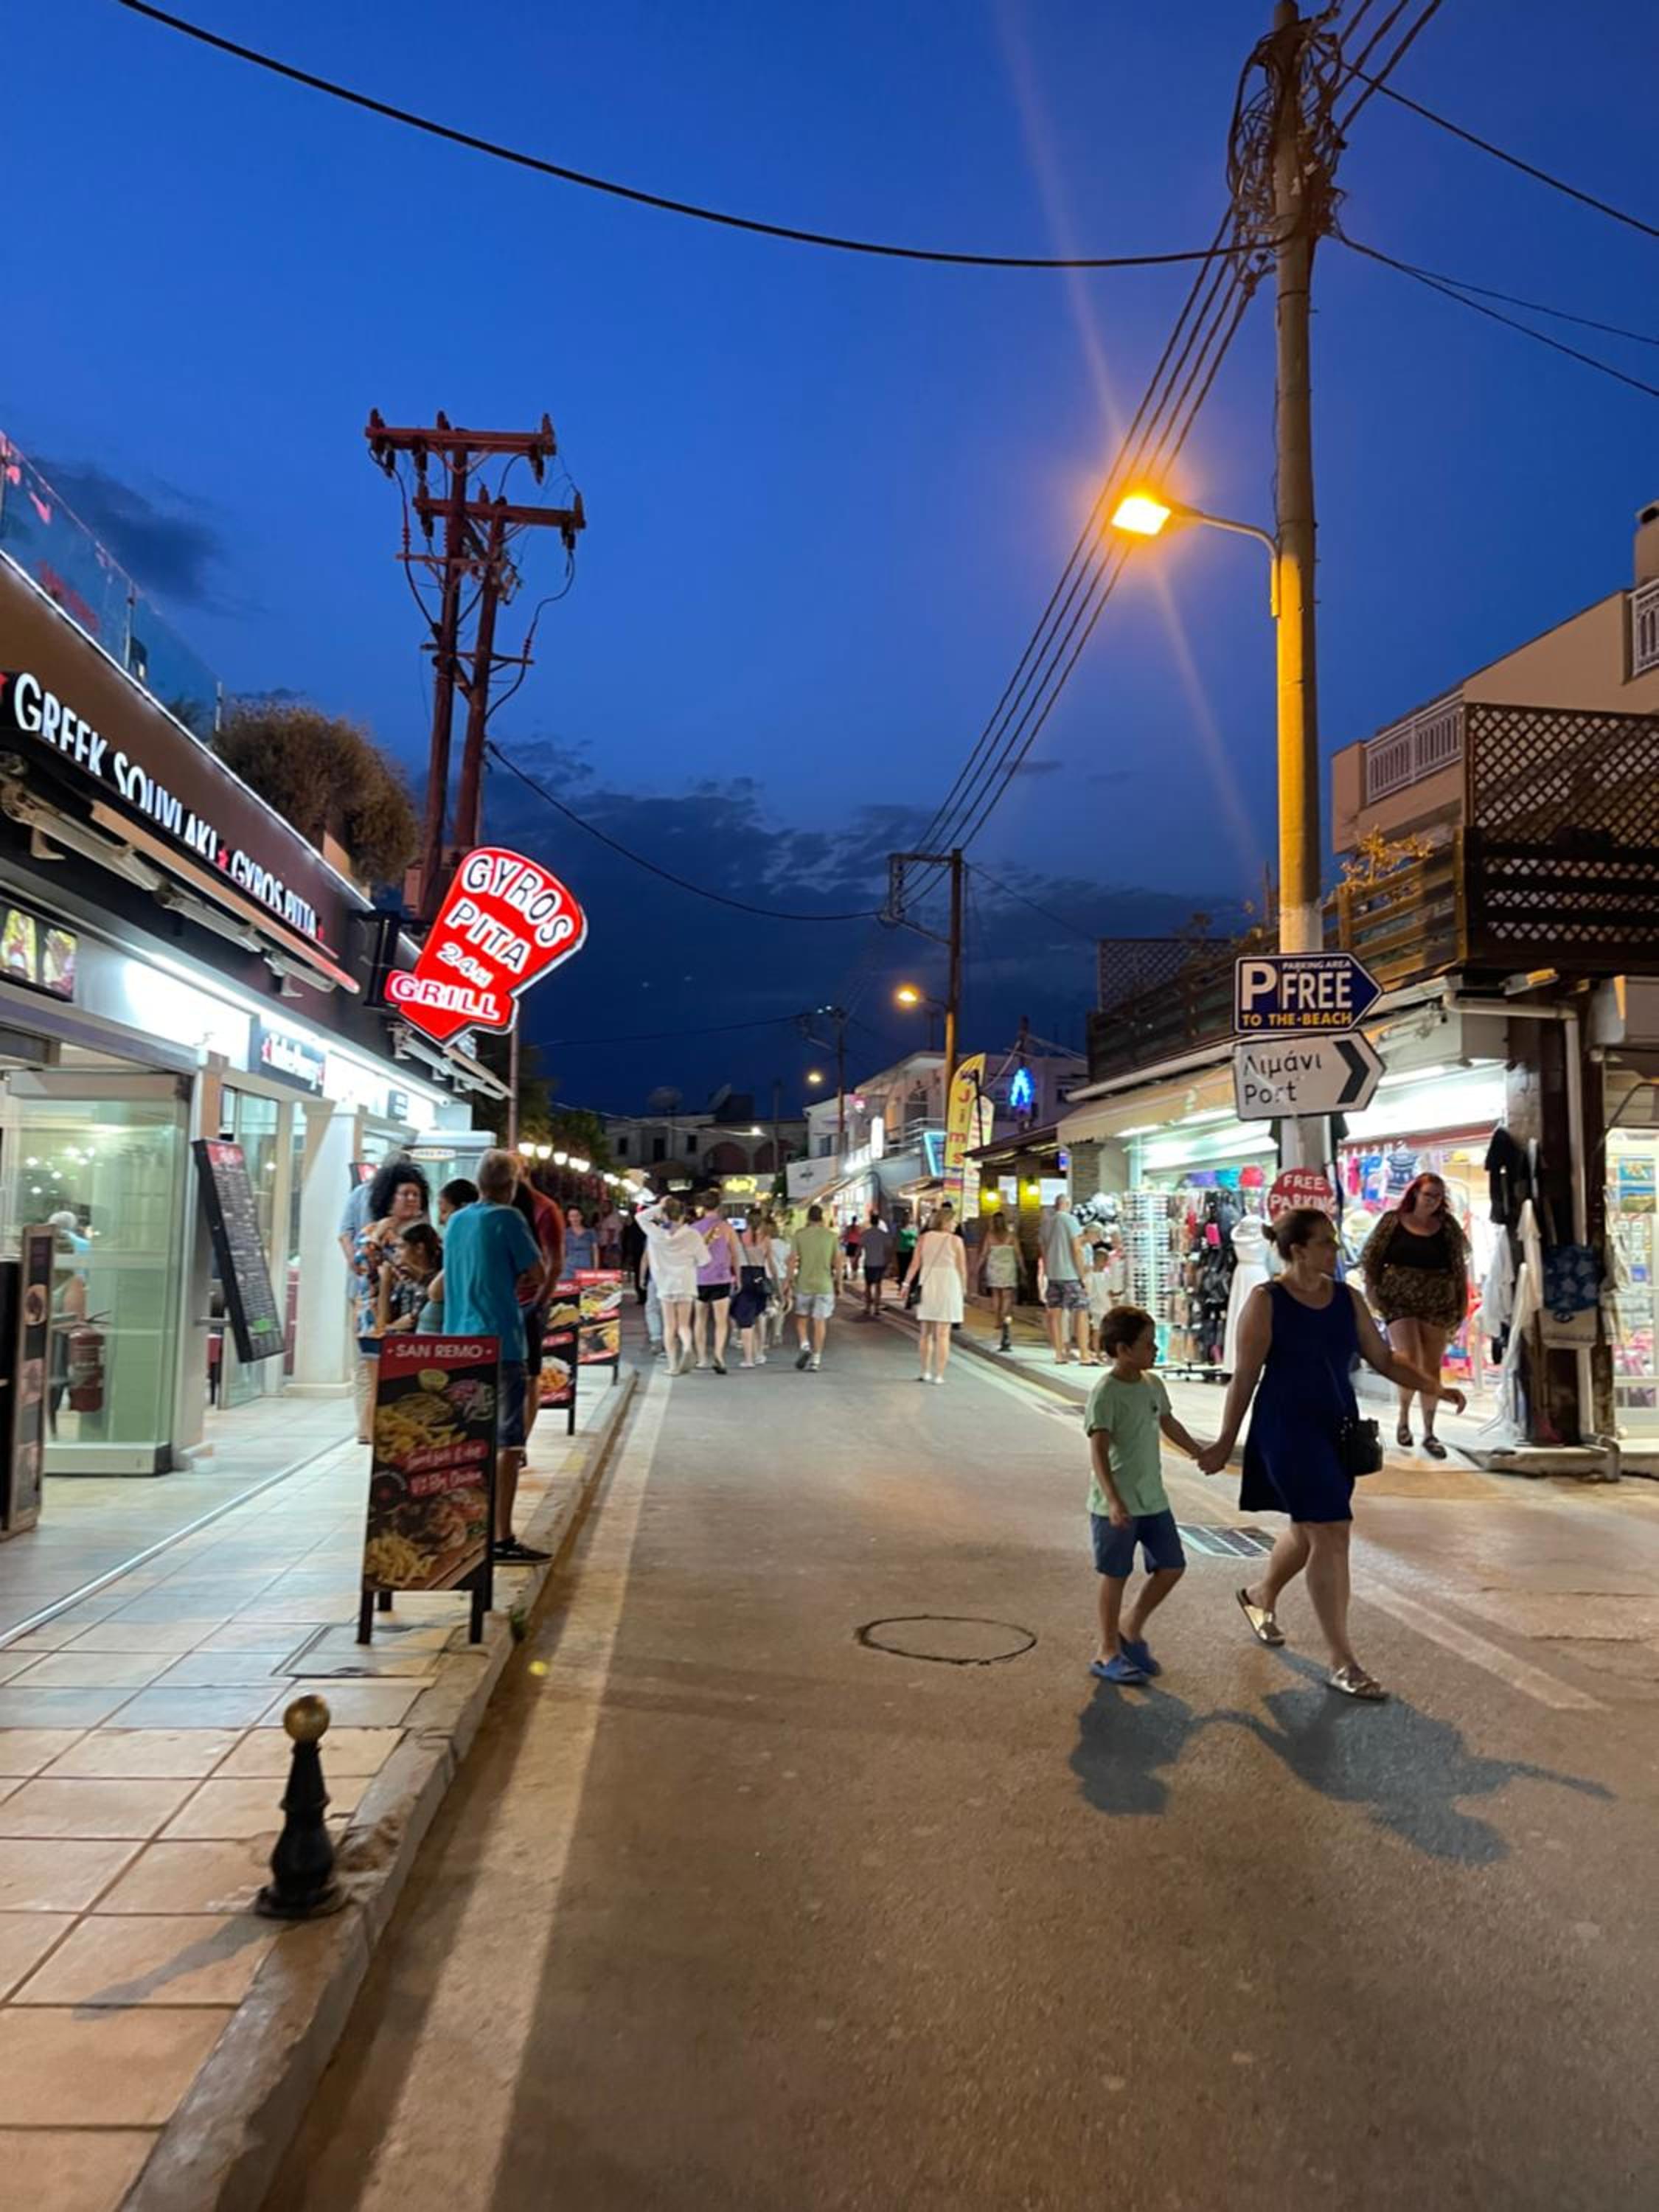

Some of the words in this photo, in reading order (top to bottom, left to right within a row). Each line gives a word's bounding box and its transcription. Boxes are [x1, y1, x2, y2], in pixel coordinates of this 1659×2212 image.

[231, 849, 284, 914] GYROS
[461, 854, 575, 948] GYROS
[443, 897, 532, 975] PITA
[1282, 961, 1323, 971] PARKING
[1325, 960, 1352, 970] AREA
[391, 975, 499, 1020] GRILL
[1241, 961, 1277, 1011] P
[1282, 971, 1352, 1010] FREE
[1242, 1014, 1262, 1026] TO
[1268, 1013, 1295, 1026] THE
[1301, 1012, 1352, 1026] BEACH
[1242, 1050, 1322, 1079] Λιμάνι
[1244, 1081, 1297, 1106] Port
[1282, 1174, 1326, 1192] FREE
[1269, 1194, 1338, 1213] PARKING
[395, 1344, 431, 1357] SAN
[434, 1344, 483, 1357] REMO
